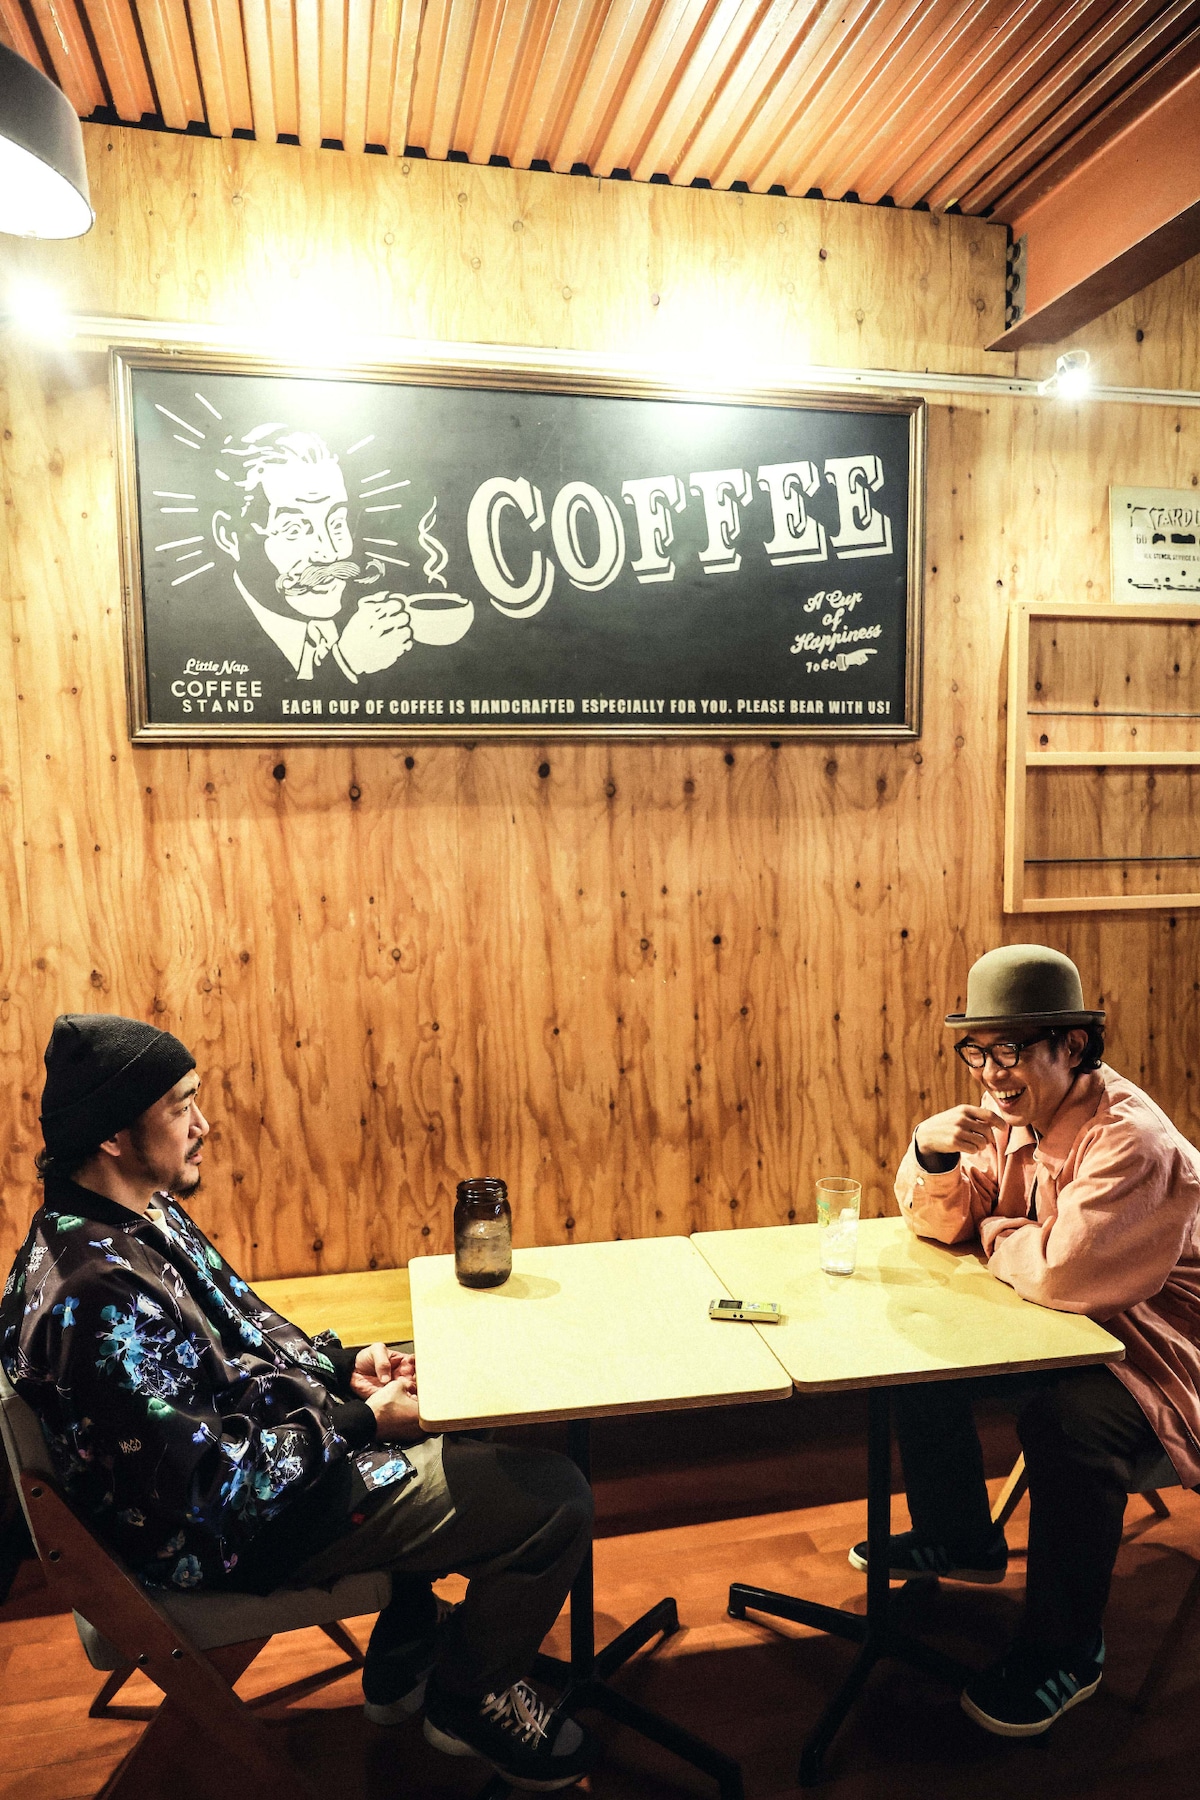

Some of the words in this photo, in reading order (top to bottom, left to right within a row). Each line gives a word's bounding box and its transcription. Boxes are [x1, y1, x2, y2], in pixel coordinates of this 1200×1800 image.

[466, 453, 894, 619] COFFEE
[803, 591, 826, 613] A
[826, 589, 864, 612] Cup
[822, 607, 846, 632] of
[790, 624, 883, 655] Happiness
[183, 658, 219, 676] Little
[215, 660, 250, 676] Nap
[171, 680, 263, 698] COFFEE
[182, 699, 254, 713] STAND
[282, 699, 323, 715] EACH
[329, 699, 360, 715] CUP
[366, 699, 384, 715] OF
[390, 699, 444, 715] COFFEE
[450, 699, 465, 715] IS
[471, 699, 575, 715] HANDCRAFTED
[582, 699, 665, 715] ESPECIALLY
[671, 699, 696, 715] FOR
[701, 699, 733, 715] YOU.
[738, 699, 785, 715] PLEASE
[791, 699, 824, 715] BEAR
[829, 699, 863, 715] WITH
[868, 699, 891, 715] US!
